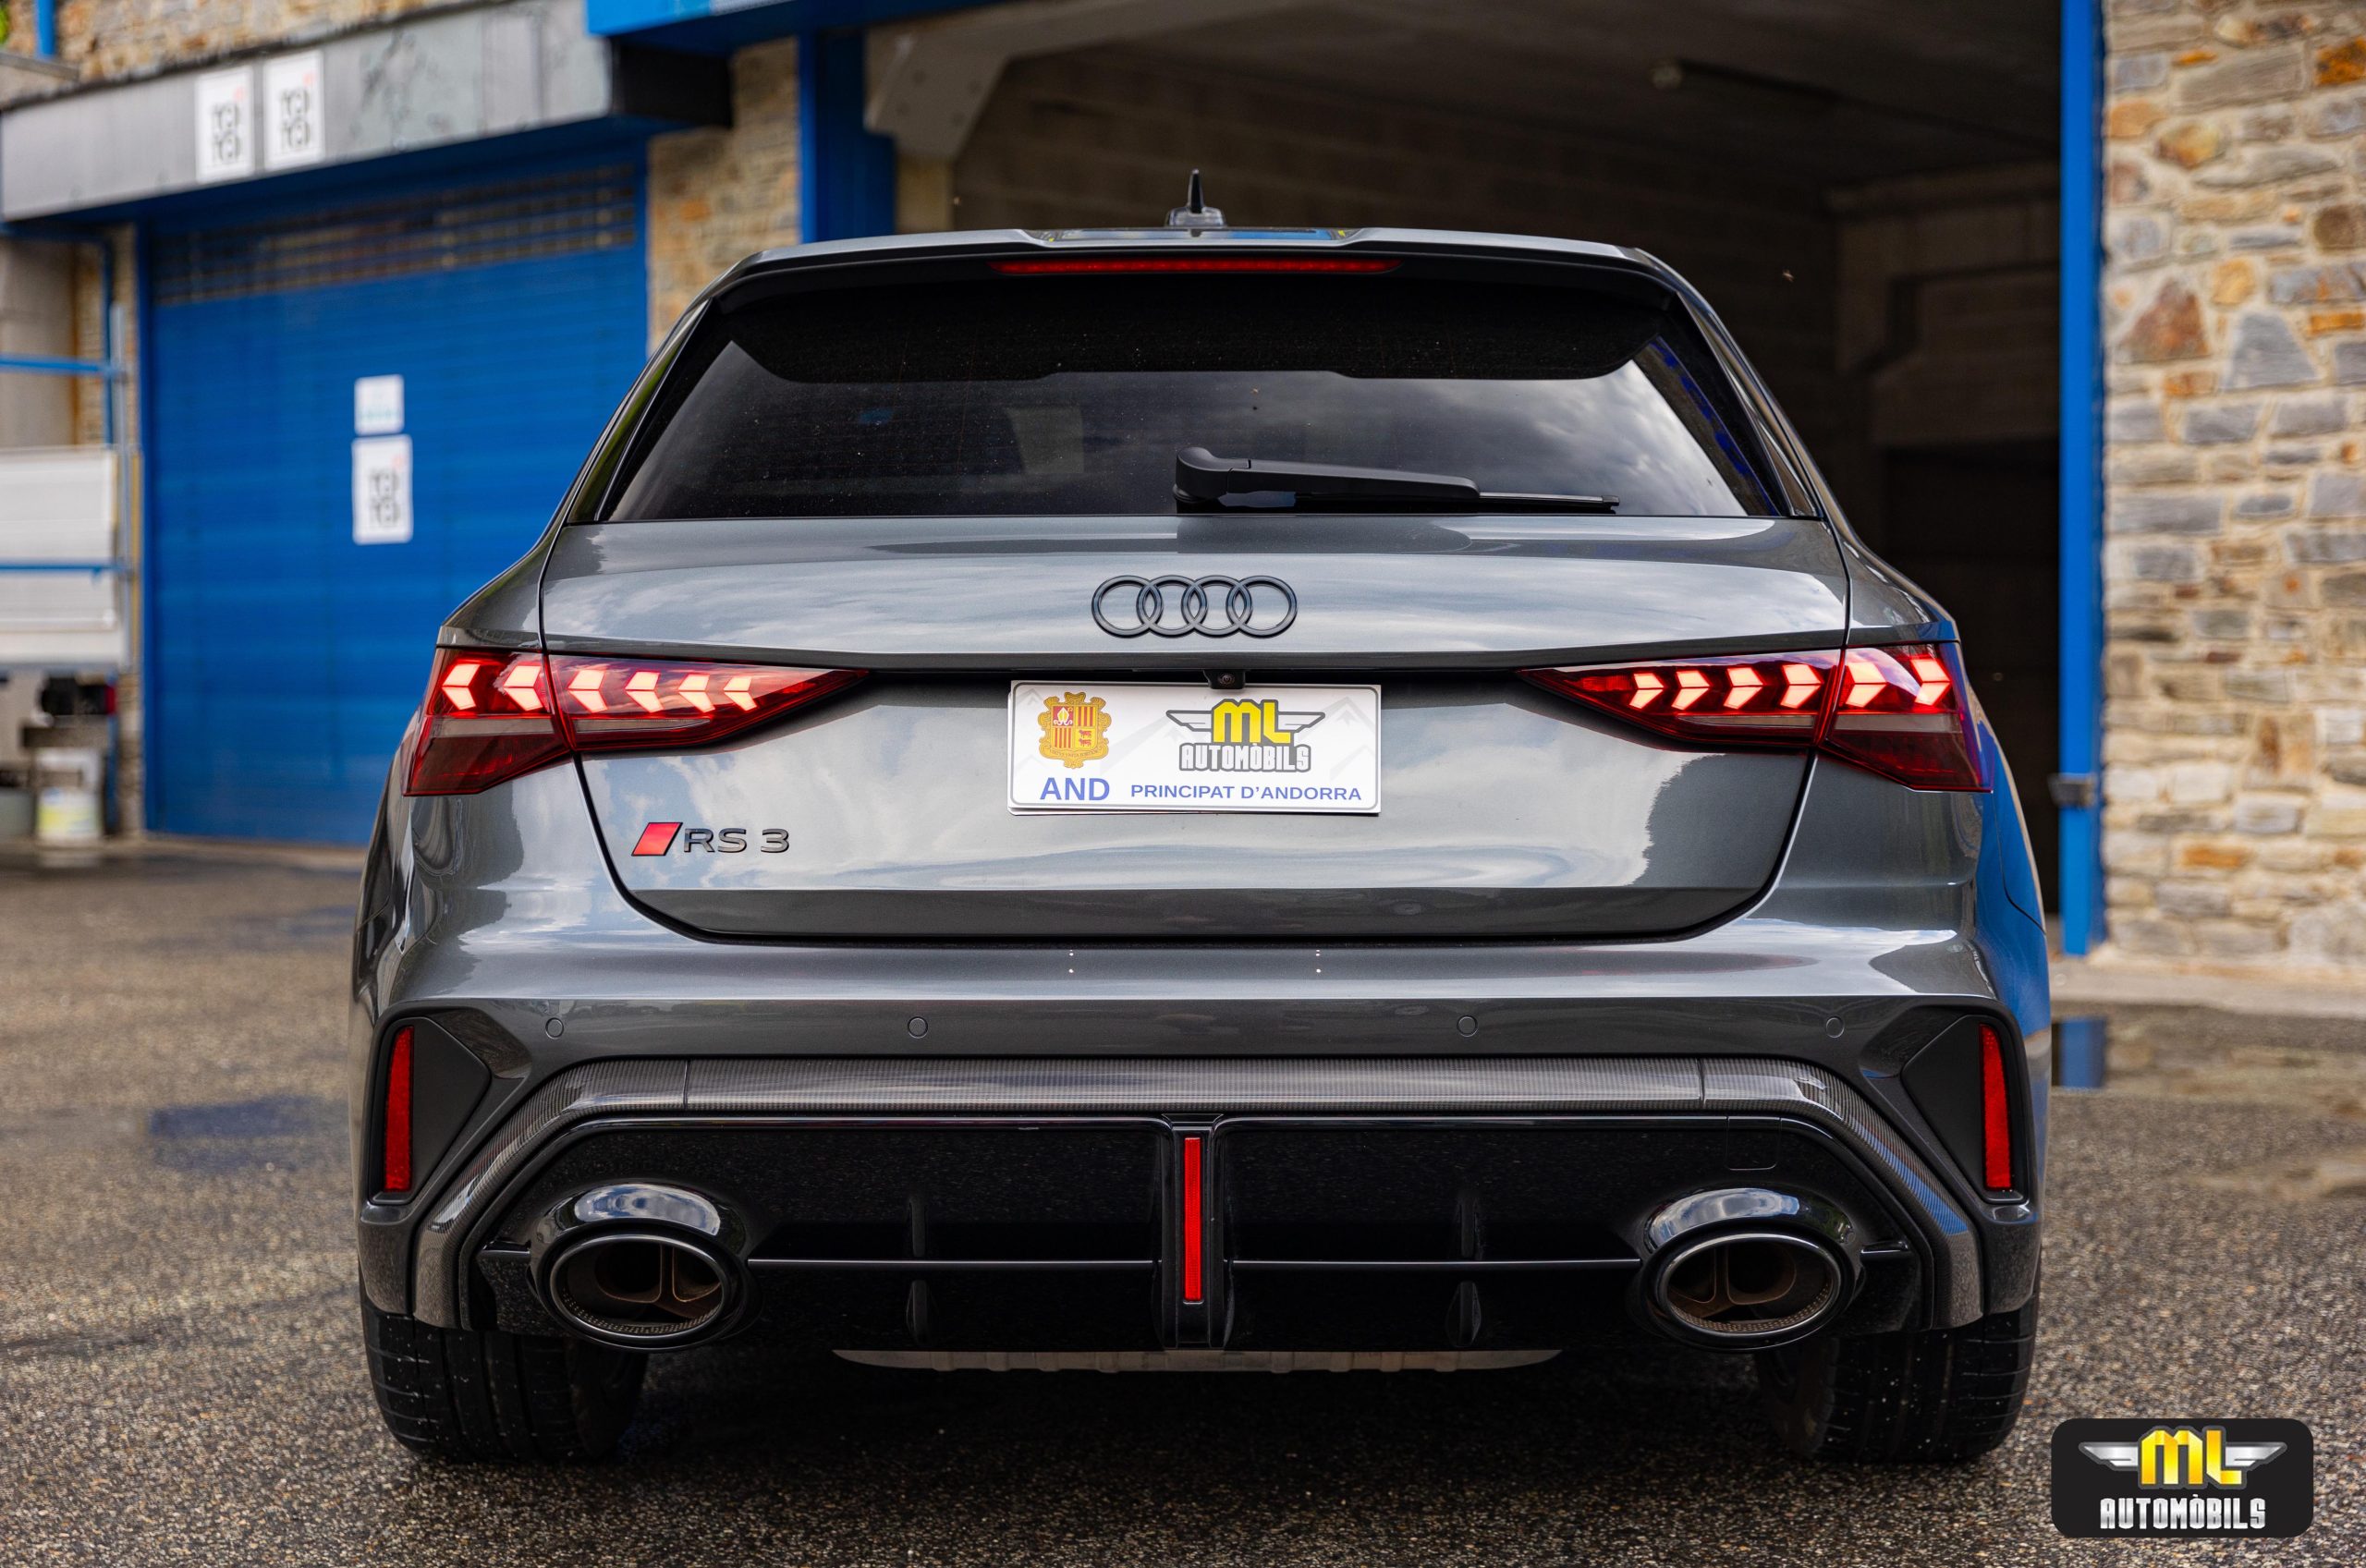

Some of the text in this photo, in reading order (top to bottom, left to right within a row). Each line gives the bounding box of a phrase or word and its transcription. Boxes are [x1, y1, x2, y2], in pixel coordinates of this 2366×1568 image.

[1212, 699, 1293, 745] ML
[1040, 777, 1110, 801] AND
[1130, 784, 1362, 801] PRINCIPAT D'ANDORRA
[683, 827, 790, 854] RS 3
